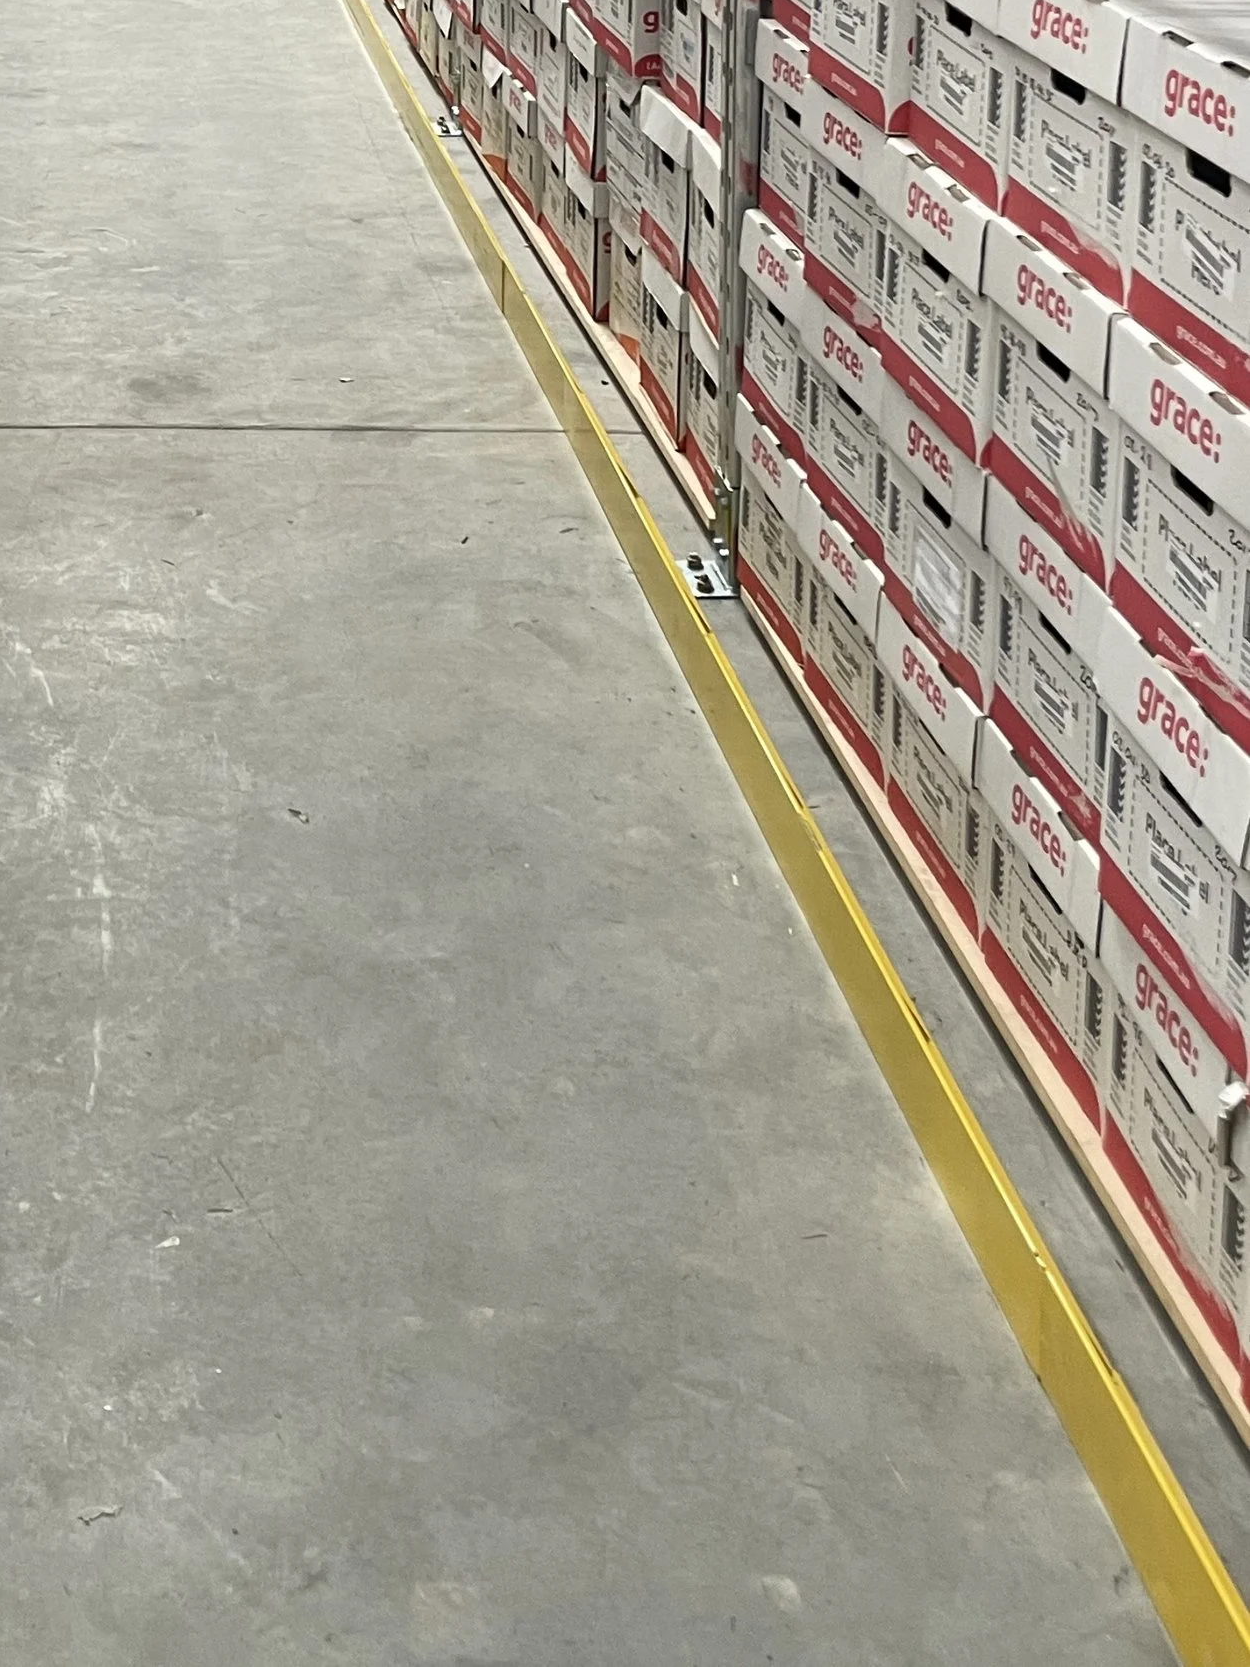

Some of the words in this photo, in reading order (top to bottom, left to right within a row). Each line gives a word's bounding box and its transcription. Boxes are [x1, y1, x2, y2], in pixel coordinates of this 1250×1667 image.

[822, 110, 863, 161] grace:
[1163, 67, 1238, 137] grace:
[906, 180, 955, 243] grace:
[1016, 263, 1075, 334] grace:
[822, 324, 865, 384] grace:
[906, 418, 954, 491] grace:
[1149, 378, 1223, 465] grace:
[817, 526, 858, 599] grace:
[1017, 532, 1075, 617] grace:
[900, 642, 948, 722] grace:
[1136, 675, 1210, 779] grace:
[1010, 782, 1068, 879] grace:
[1134, 962, 1200, 1078] grace:
